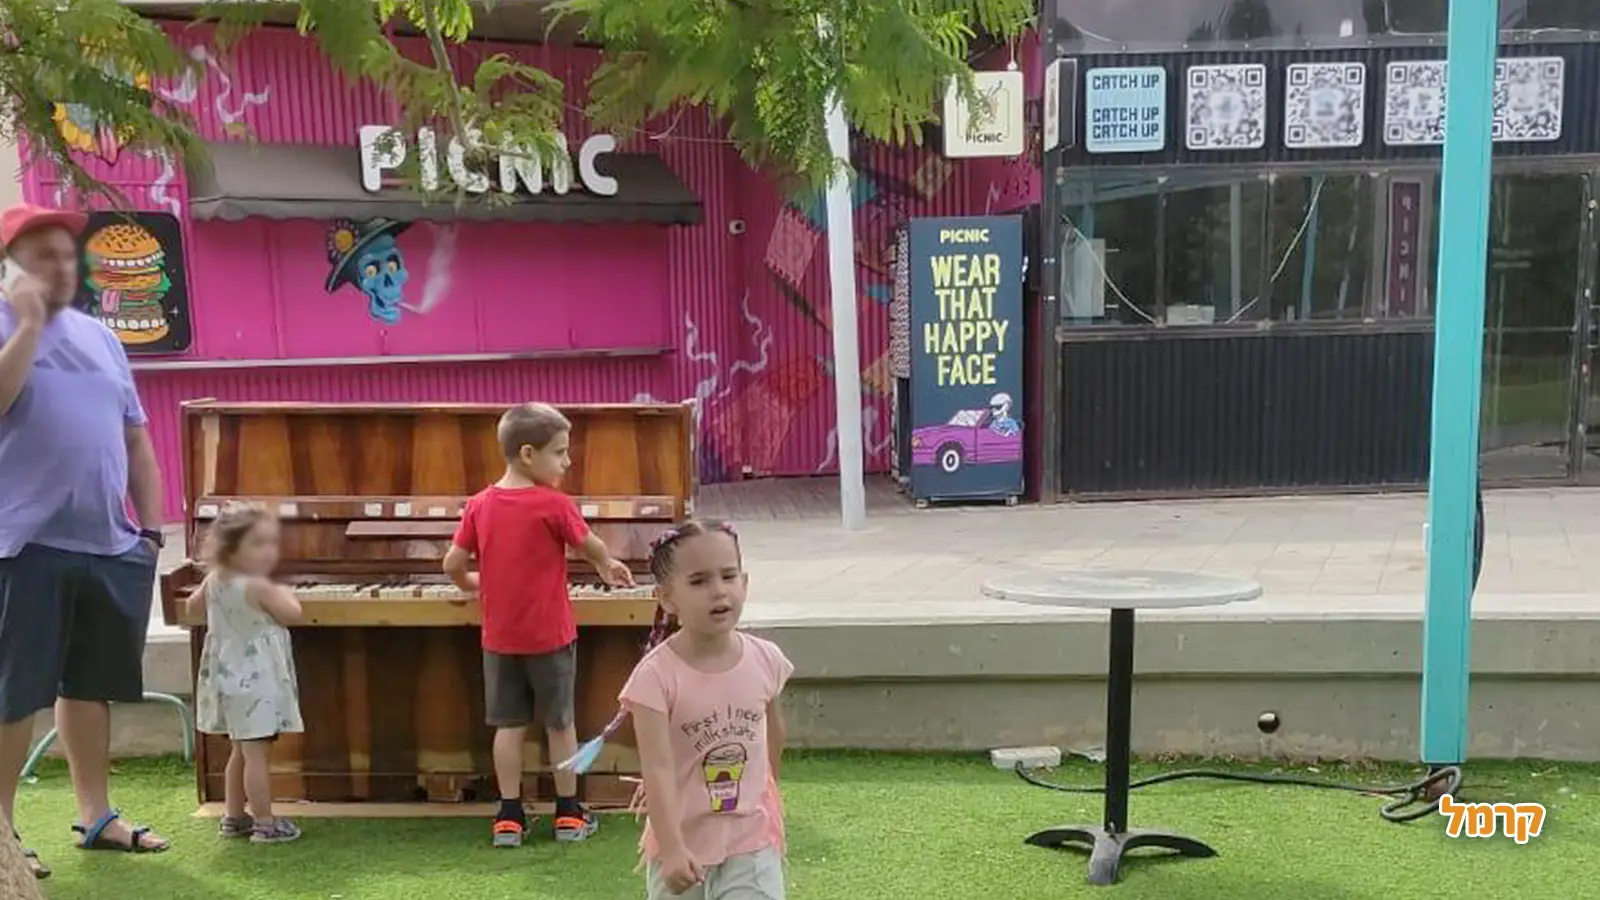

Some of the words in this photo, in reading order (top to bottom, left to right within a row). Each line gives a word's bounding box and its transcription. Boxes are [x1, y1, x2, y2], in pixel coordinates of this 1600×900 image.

[1092, 75, 1138, 90] CATCH
[1141, 74, 1159, 88] UP
[1092, 109, 1138, 123] CATCH
[1141, 108, 1159, 121] UP
[965, 132, 1003, 143] PICNIC
[1092, 124, 1138, 138] CATCH
[1141, 123, 1159, 136] UP
[359, 124, 618, 196] PICNIC
[940, 229, 990, 243] PICNIC
[930, 254, 1001, 287] WEAR
[934, 287, 997, 320] THAT
[924, 319, 1009, 354] HAPPY
[937, 353, 997, 386] FACE
